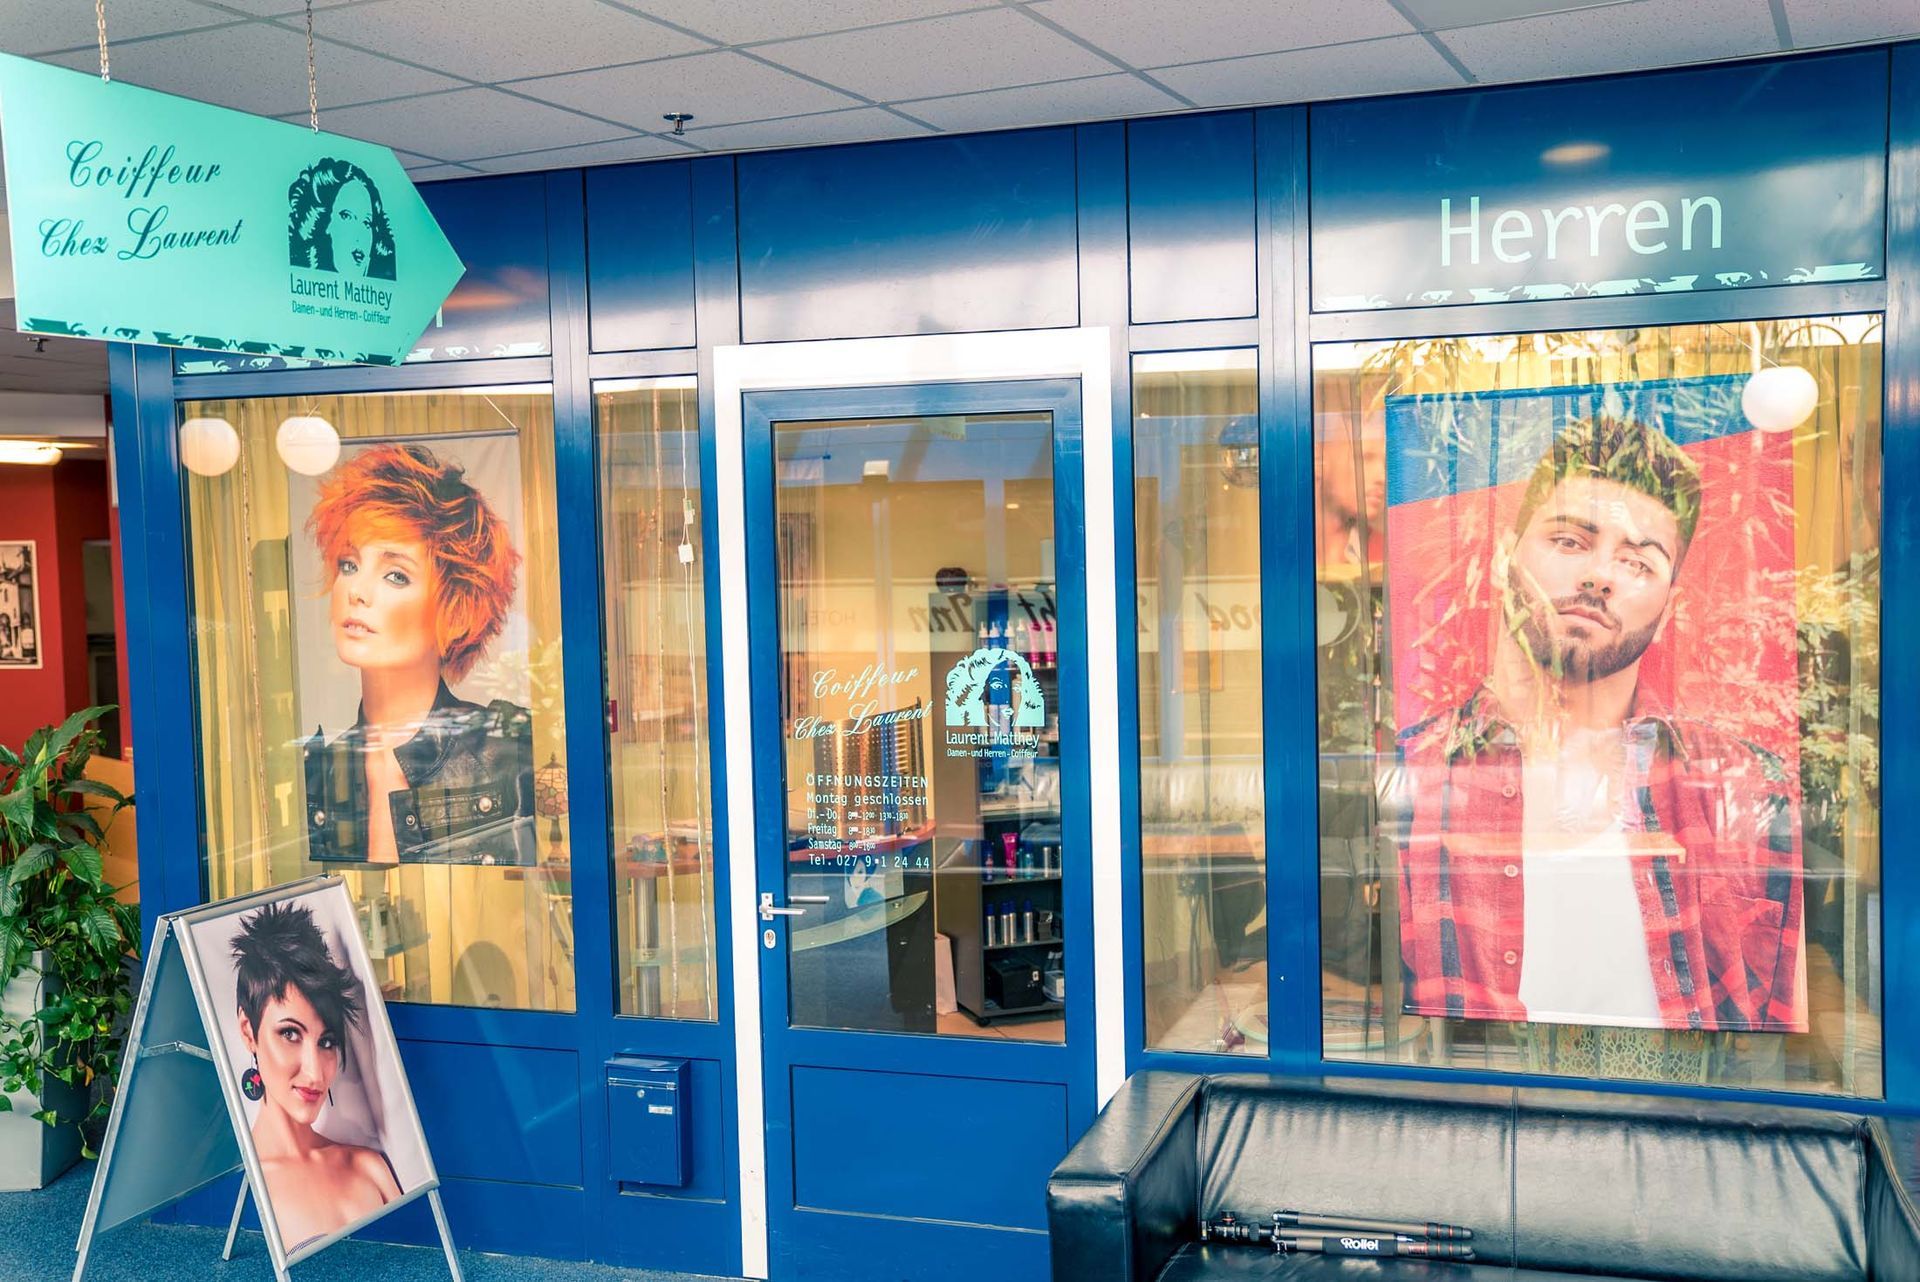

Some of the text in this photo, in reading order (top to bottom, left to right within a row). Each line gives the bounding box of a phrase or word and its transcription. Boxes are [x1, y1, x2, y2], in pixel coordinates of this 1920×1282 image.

[66, 140, 221, 198] Coiffeur
[38, 205, 243, 261] Chez Laurent
[1441, 196, 1722, 267] Herren
[290, 272, 393, 311] Laurent Matthey
[812, 661, 919, 700] Coiffeur
[794, 699, 934, 740] Chez Laurent
[945, 730, 1040, 749] Laurent Matthey
[805, 772, 929, 788] ÖFFNUNGSZEITEN
[806, 791, 929, 807] Montag geschlossen
[807, 822, 837, 837] Freitag
[808, 838, 842, 853] Samstag
[808, 853, 832, 867] Tel.
[836, 854, 858, 867] 027
[894, 856, 909, 868] 24
[915, 857, 930, 869] 44
